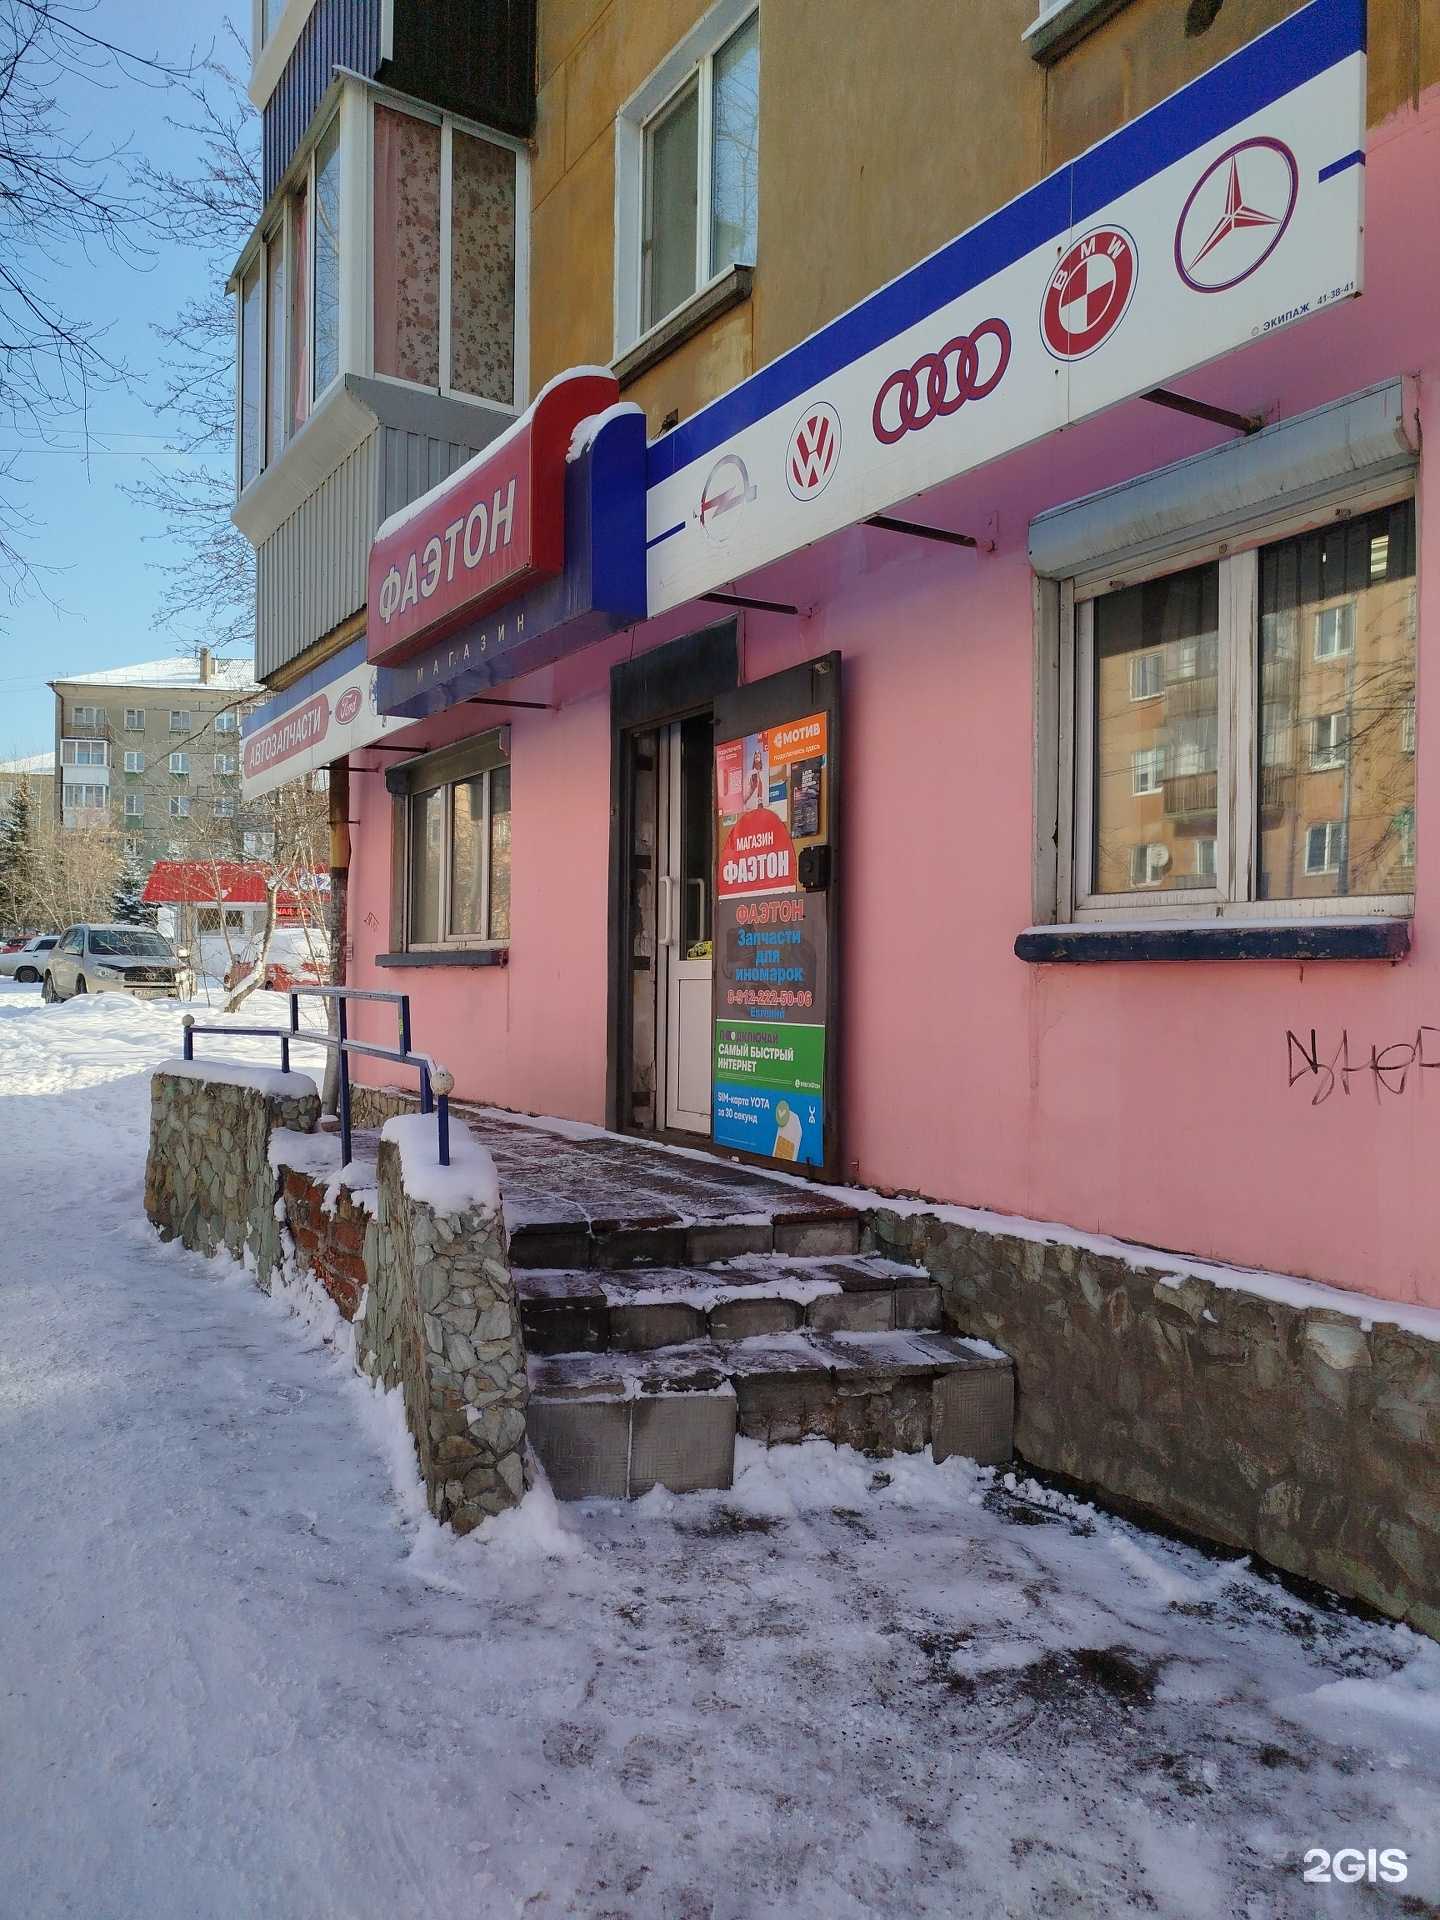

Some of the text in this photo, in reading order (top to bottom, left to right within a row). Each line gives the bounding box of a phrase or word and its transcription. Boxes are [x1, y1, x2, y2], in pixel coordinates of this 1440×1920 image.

[1052, 236, 1126, 291] BMW
[1263, 302, 1310, 331] ЭКИПАЖ
[1317, 281, 1354, 305] 41-38-41
[378, 479, 517, 624] ФАЭТОН
[416, 613, 525, 682] МАГАЗИН
[248, 706, 322, 769] АВТОЗАПЧАСТИ
[782, 722, 821, 745] МОТИВ
[736, 831, 774, 852] МАГАЗИН
[723, 850, 790, 884] ФАЭТОН
[736, 899, 804, 925] ФАЭТОН
[738, 927, 801, 946] Запчасти
[755, 951, 780, 968] для
[736, 967, 805, 985] иномарок
[718, 1043, 794, 1062] САМЫЙ БЫСТРЫЙ
[718, 1057, 757, 1073] ИНТЕРНЕТ
[717, 1091, 770, 1110] SIM-карта YOTA
[725, 1107, 733, 1118] 30
[734, 1111, 758, 1124] секунд
